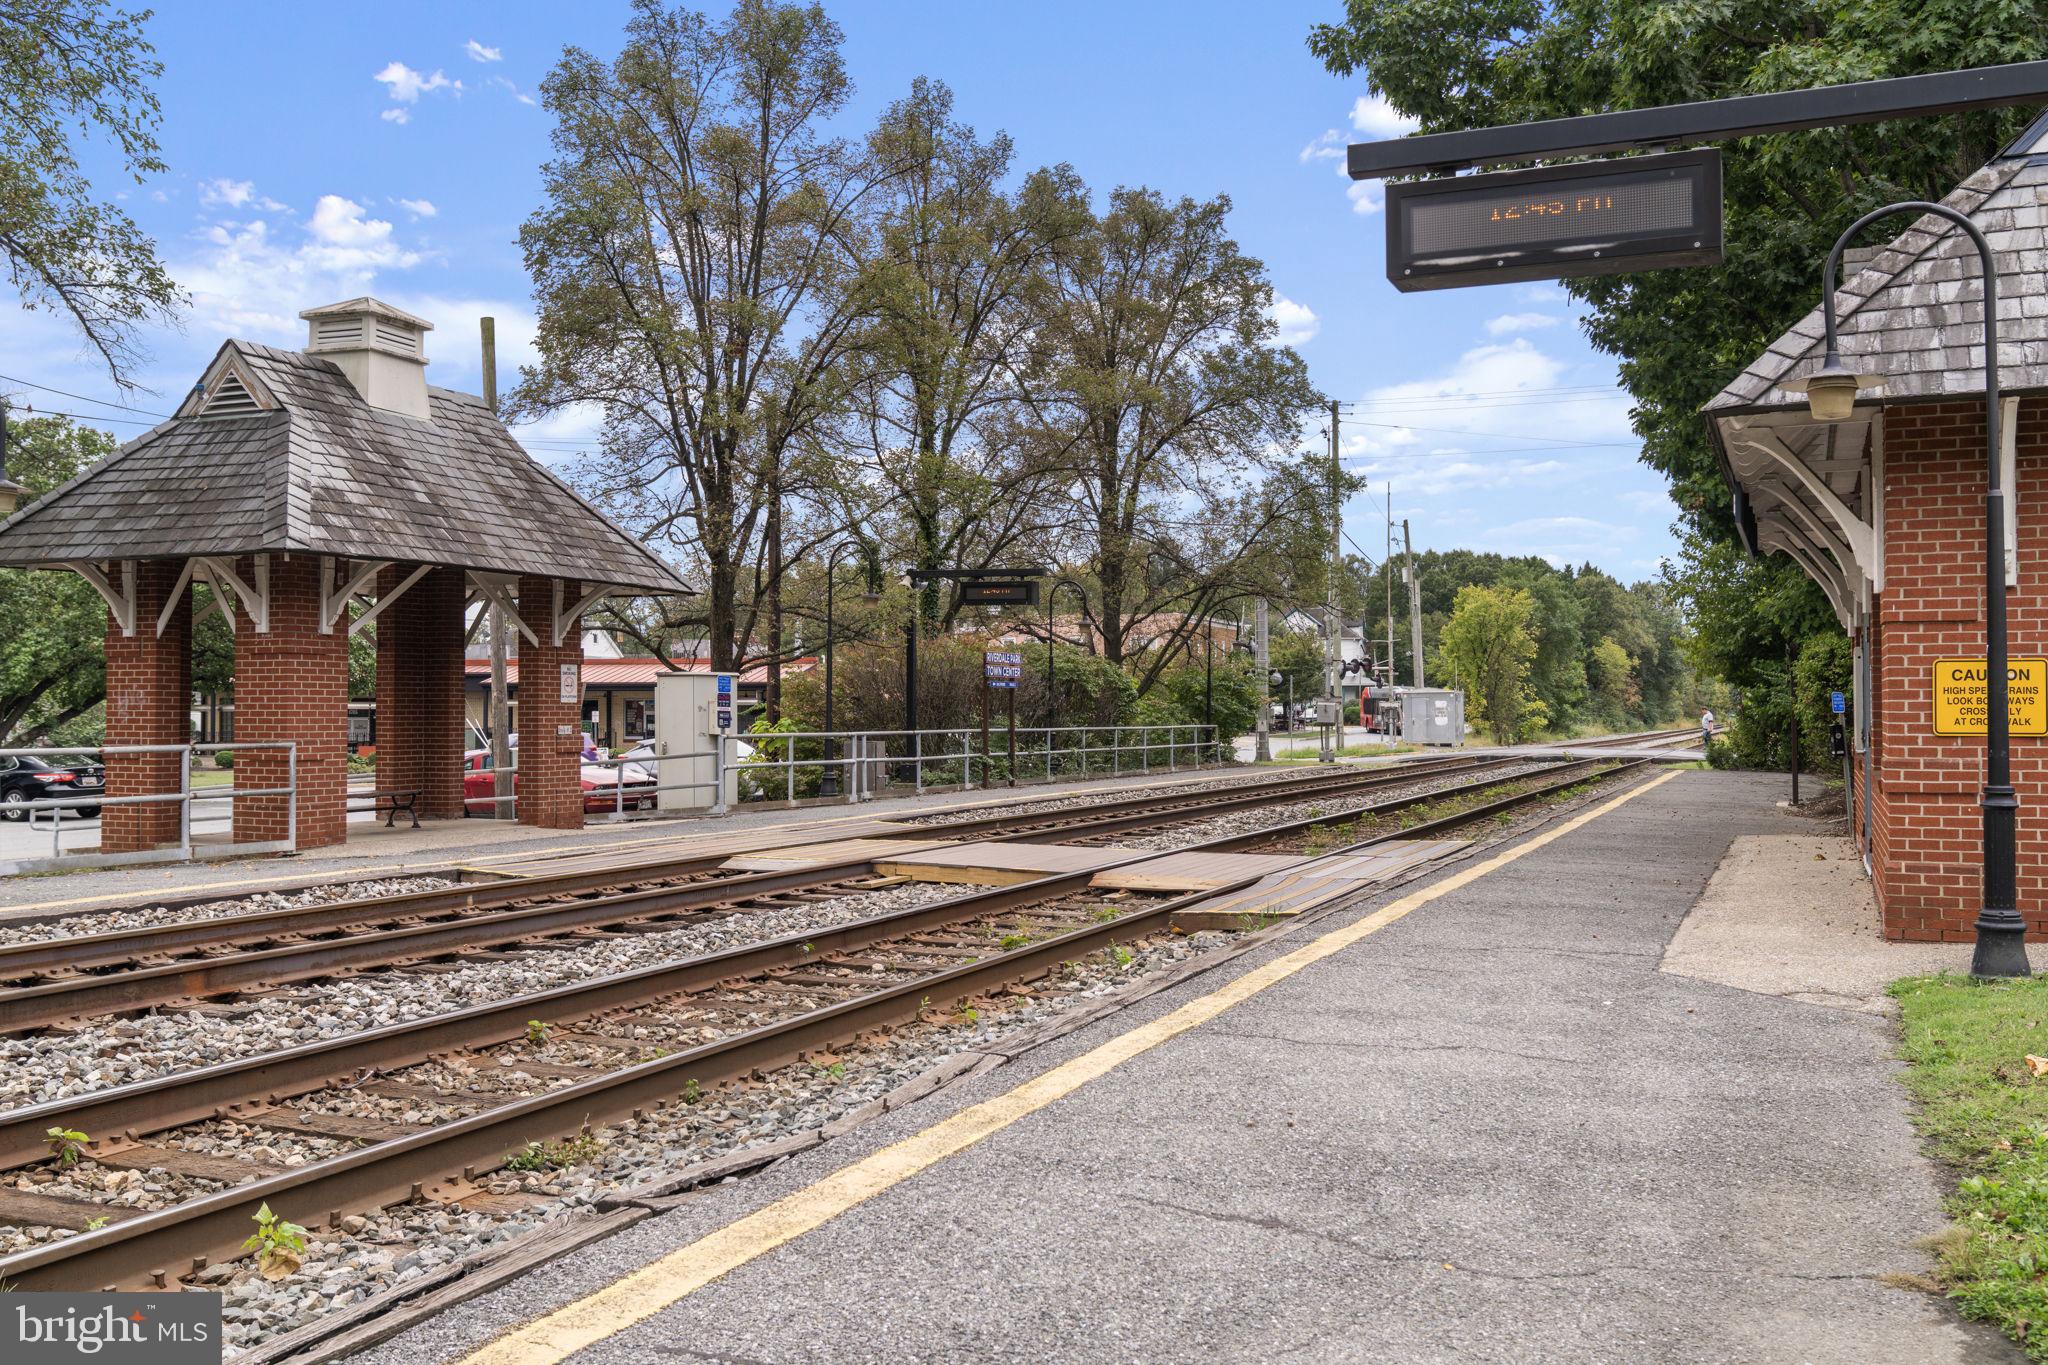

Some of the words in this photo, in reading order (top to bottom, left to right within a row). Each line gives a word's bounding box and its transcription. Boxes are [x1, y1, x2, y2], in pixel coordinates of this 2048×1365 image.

[987, 665, 1002, 676] TOWN
[1003, 667, 1021, 677] CENTER
[1951, 669, 2030, 681] CAUON
[1947, 697, 1973, 705] LOOK
[1976, 697, 1988, 705] BO
